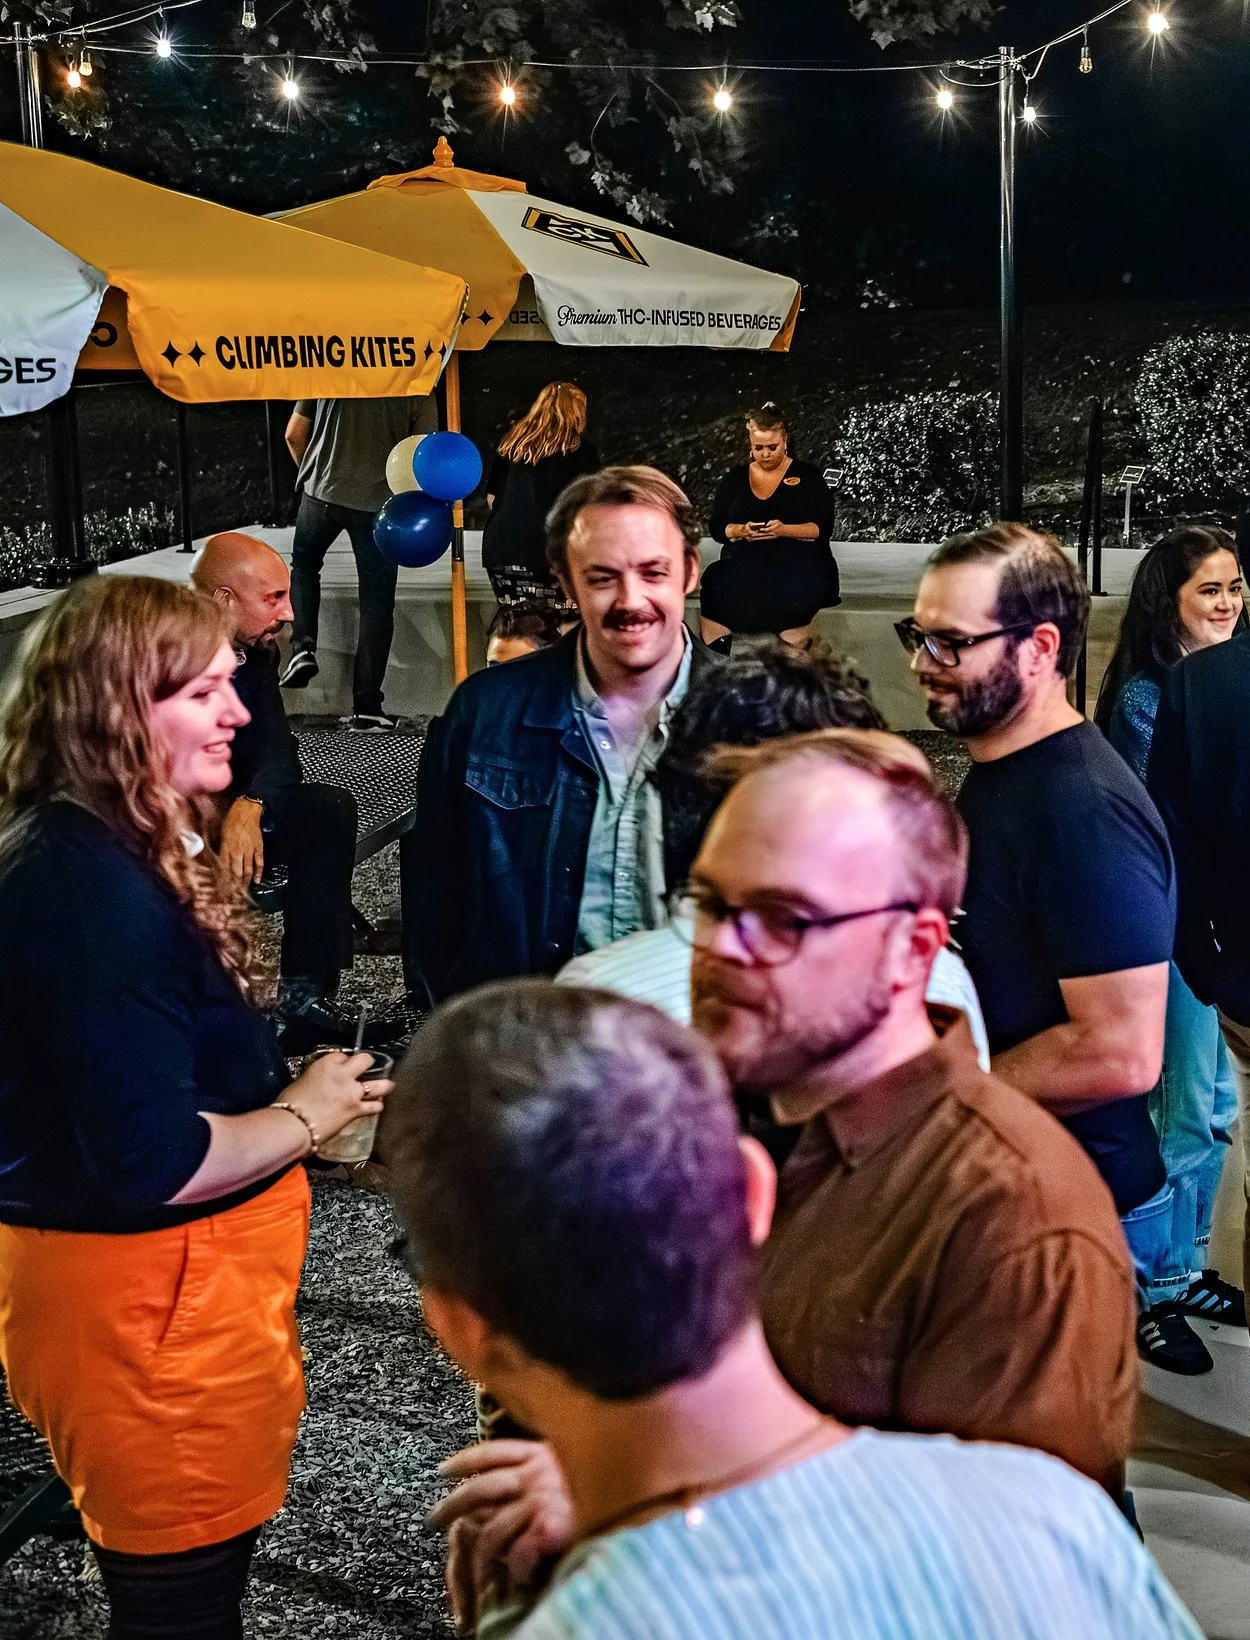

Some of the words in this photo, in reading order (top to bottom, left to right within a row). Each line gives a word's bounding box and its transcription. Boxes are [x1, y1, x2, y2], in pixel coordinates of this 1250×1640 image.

[557, 304, 618, 327] Premium
[617, 308, 705, 327] THC-INFUSED
[708, 310, 783, 331] BEVERAGES
[215, 335, 345, 370] CLIMBING
[351, 336, 415, 368] KITES
